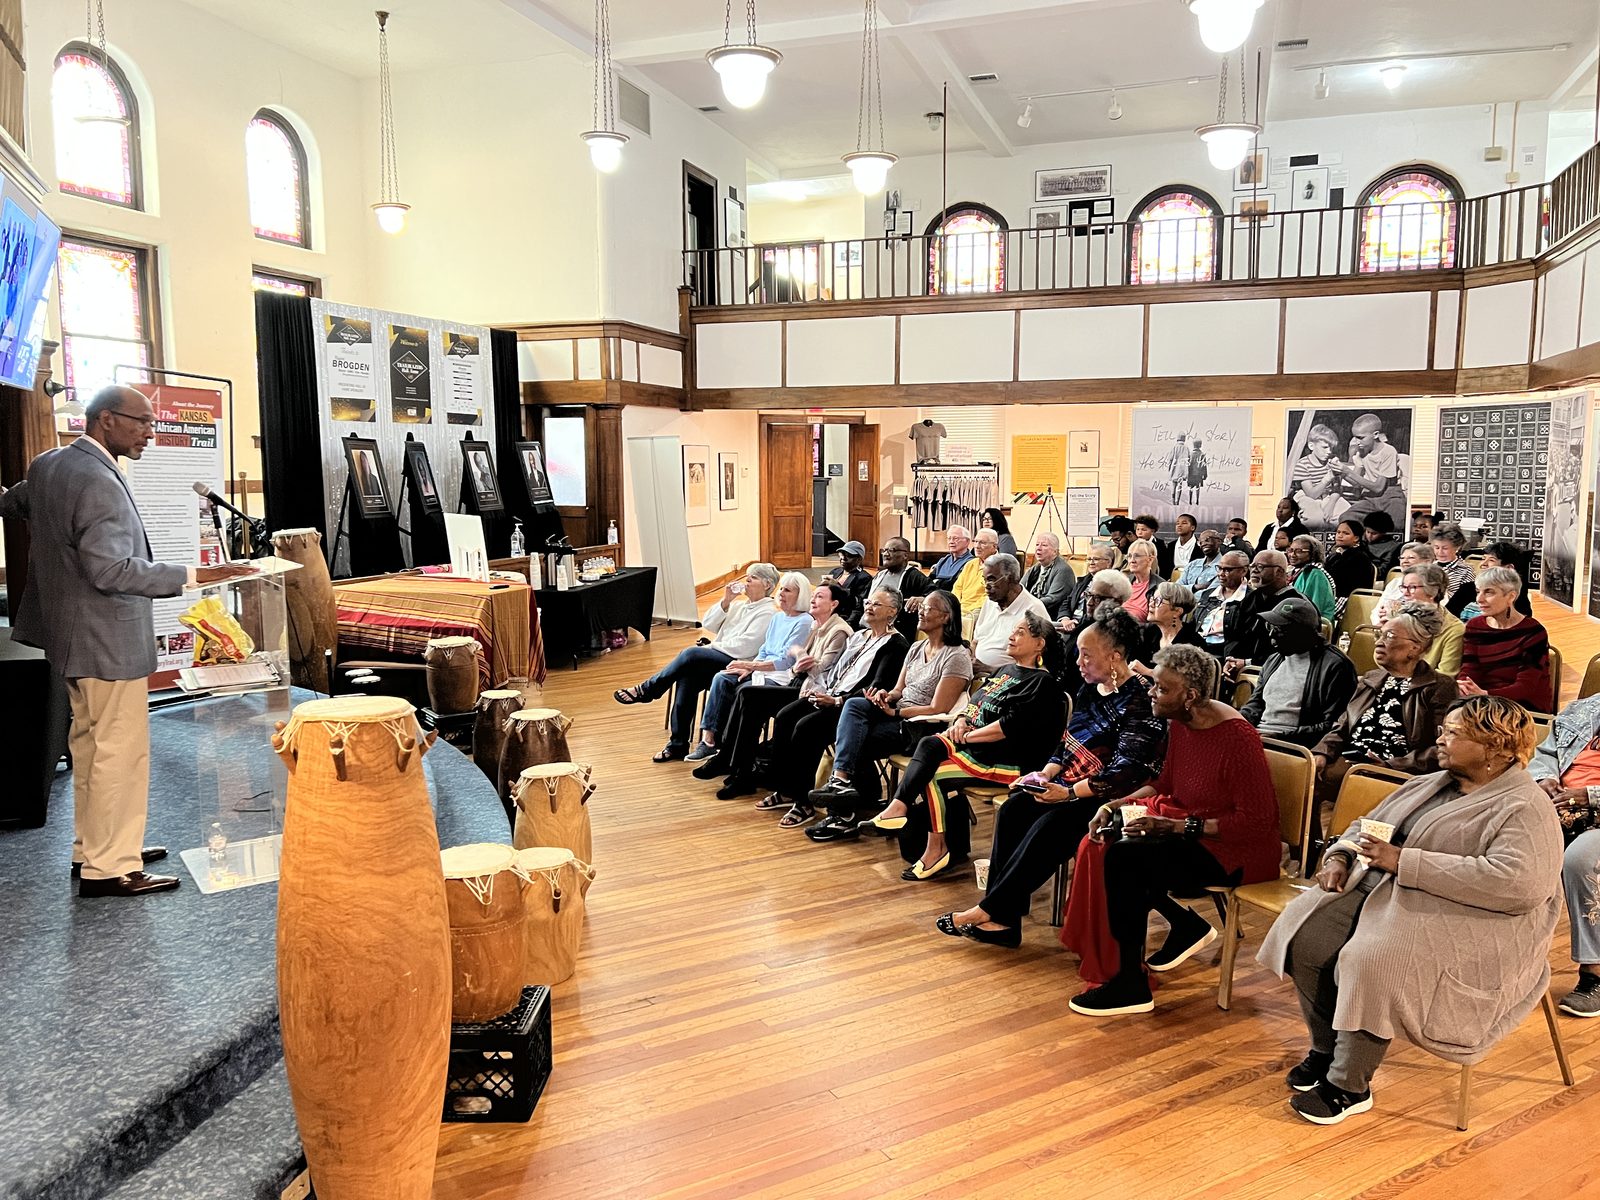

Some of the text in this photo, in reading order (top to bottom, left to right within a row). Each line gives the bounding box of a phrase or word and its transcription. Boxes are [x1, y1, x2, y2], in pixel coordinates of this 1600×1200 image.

[332, 359, 370, 371] BROGDEN
[160, 410, 208, 422] The KANSAS
[156, 421, 215, 435] African American
[158, 435, 215, 447] HISTORY Trail
